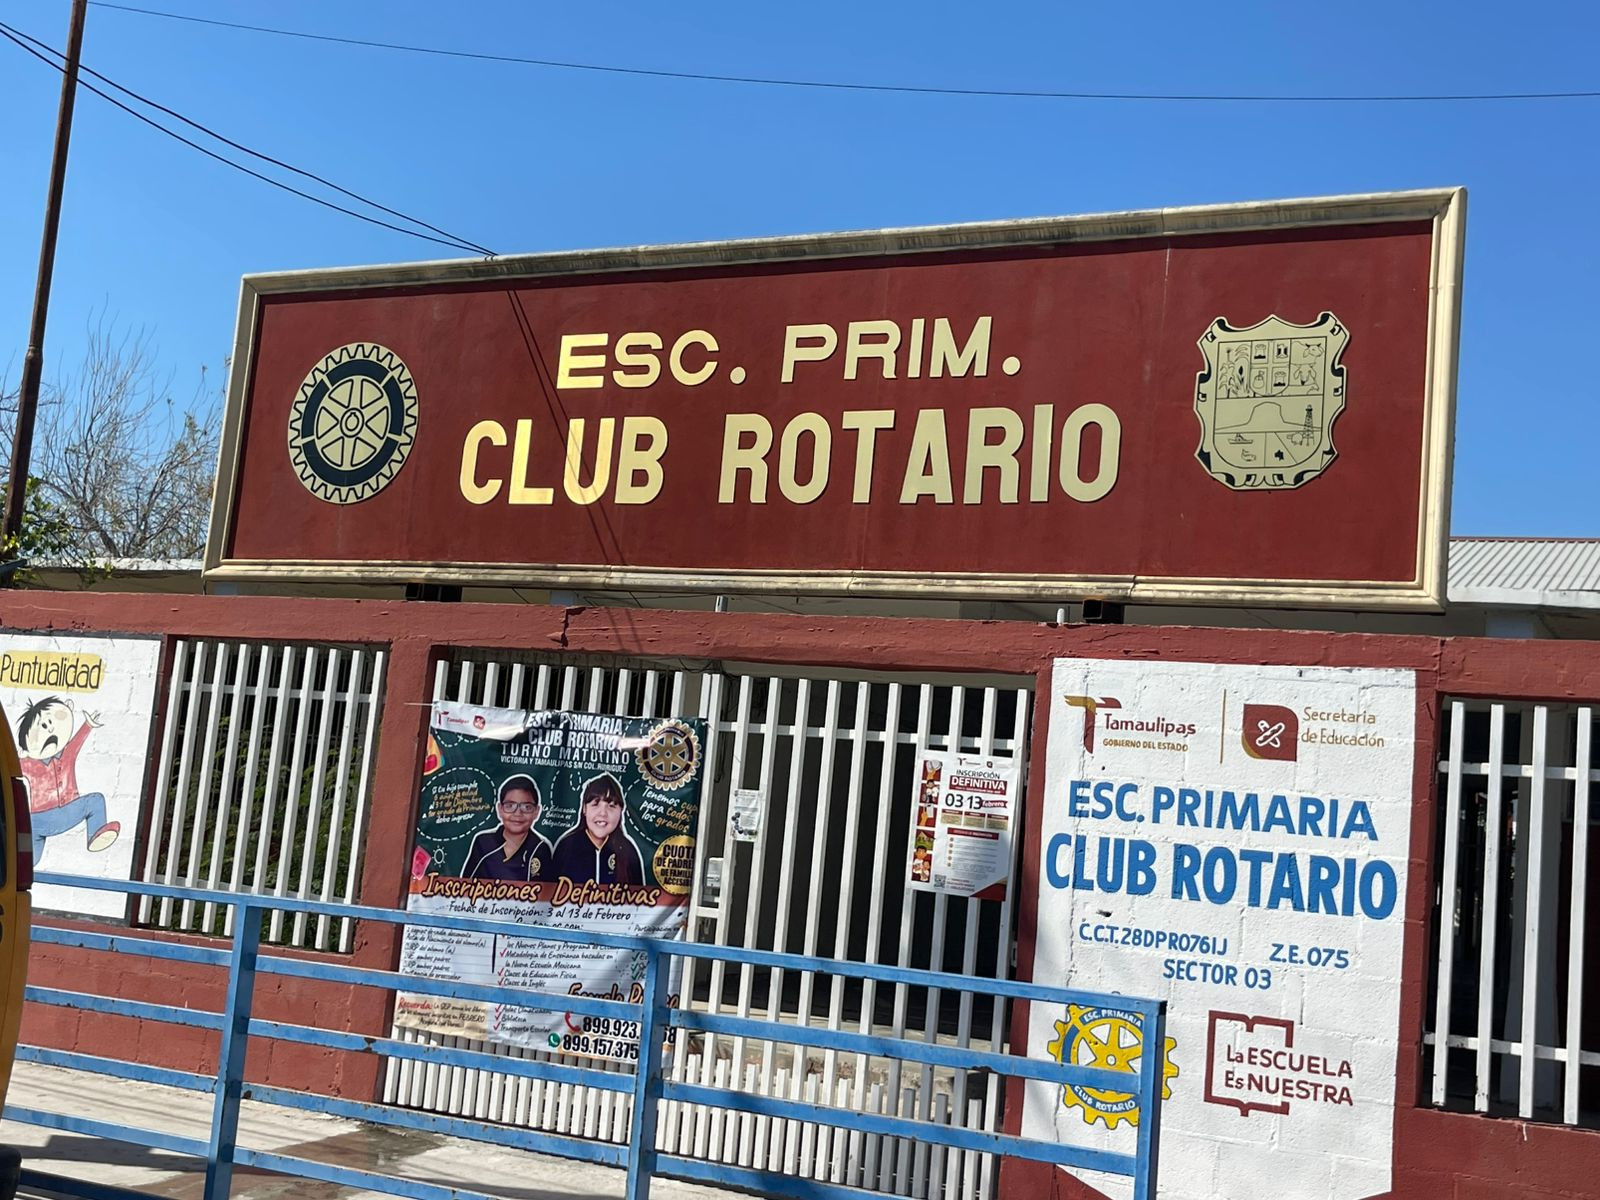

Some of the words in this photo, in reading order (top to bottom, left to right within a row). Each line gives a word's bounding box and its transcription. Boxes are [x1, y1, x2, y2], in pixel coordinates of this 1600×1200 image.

[556, 329, 746, 389] ESC.
[781, 316, 1021, 383] PRIM.
[459, 416, 669, 505] CLUB
[718, 403, 1122, 504] ROTARIO
[0, 654, 102, 690] Puntualidad
[526, 712, 555, 728] ESC.
[559, 713, 623, 735] PRIMARIA
[1104, 713, 1197, 738] Tamaulipas
[529, 728, 563, 746] CLUB
[567, 731, 622, 751] ROTARIO
[1102, 738, 1141, 749] GOBIERNO
[1143, 741, 1156, 750] DEL
[1157, 742, 1189, 753] ESTADO
[1301, 728, 1318, 744] de
[1320, 728, 1385, 748] Educación
[500, 742, 550, 758] TURNO
[559, 746, 630, 765] MATUTINO
[500, 755, 528, 765] VICTORIA
[535, 759, 573, 768] TAMAULIPAS
[951, 777, 1005, 790] DEFINITIVA
[956, 769, 1000, 779] INSCRIPCIÓN
[640, 800, 664, 813] para
[666, 806, 691, 822] todos
[642, 785, 680, 807] Tenemos
[681, 802, 698, 814] cup
[945, 793, 964, 808] 03
[967, 795, 982, 810] 13
[641, 808, 656, 822] los
[655, 817, 689, 833] grados
[1152, 786, 1379, 841] PRIMARIA
[663, 844, 694, 859] CUOT
[1046, 833, 1157, 896] CLUB
[1171, 843, 1398, 920] ROTARIO
[422, 872, 541, 905] Inscripciones
[552, 877, 660, 908] Definitivas
[449, 901, 475, 914] Fechas
[478, 903, 489, 914] de
[491, 904, 543, 919] Inscripción:
[548, 908, 553, 917] 3
[555, 907, 565, 917] al
[568, 908, 579, 918] 13
[582, 908, 593, 919] de
[594, 908, 631, 920] Febrero
[1163, 959, 1238, 986] SECTOR
[1245, 968, 1272, 990] 03
[1101, 1009, 1142, 1027] PRIMARIA
[1227, 1044, 1244, 1063] La
[1248, 1047, 1353, 1078] ESCUELA
[1074, 1085, 1093, 1105] CLUB
[1095, 1100, 1136, 1112] ROTARIO
[1225, 1070, 1244, 1089] Es
[1248, 1073, 1353, 1106] NUESTRA
